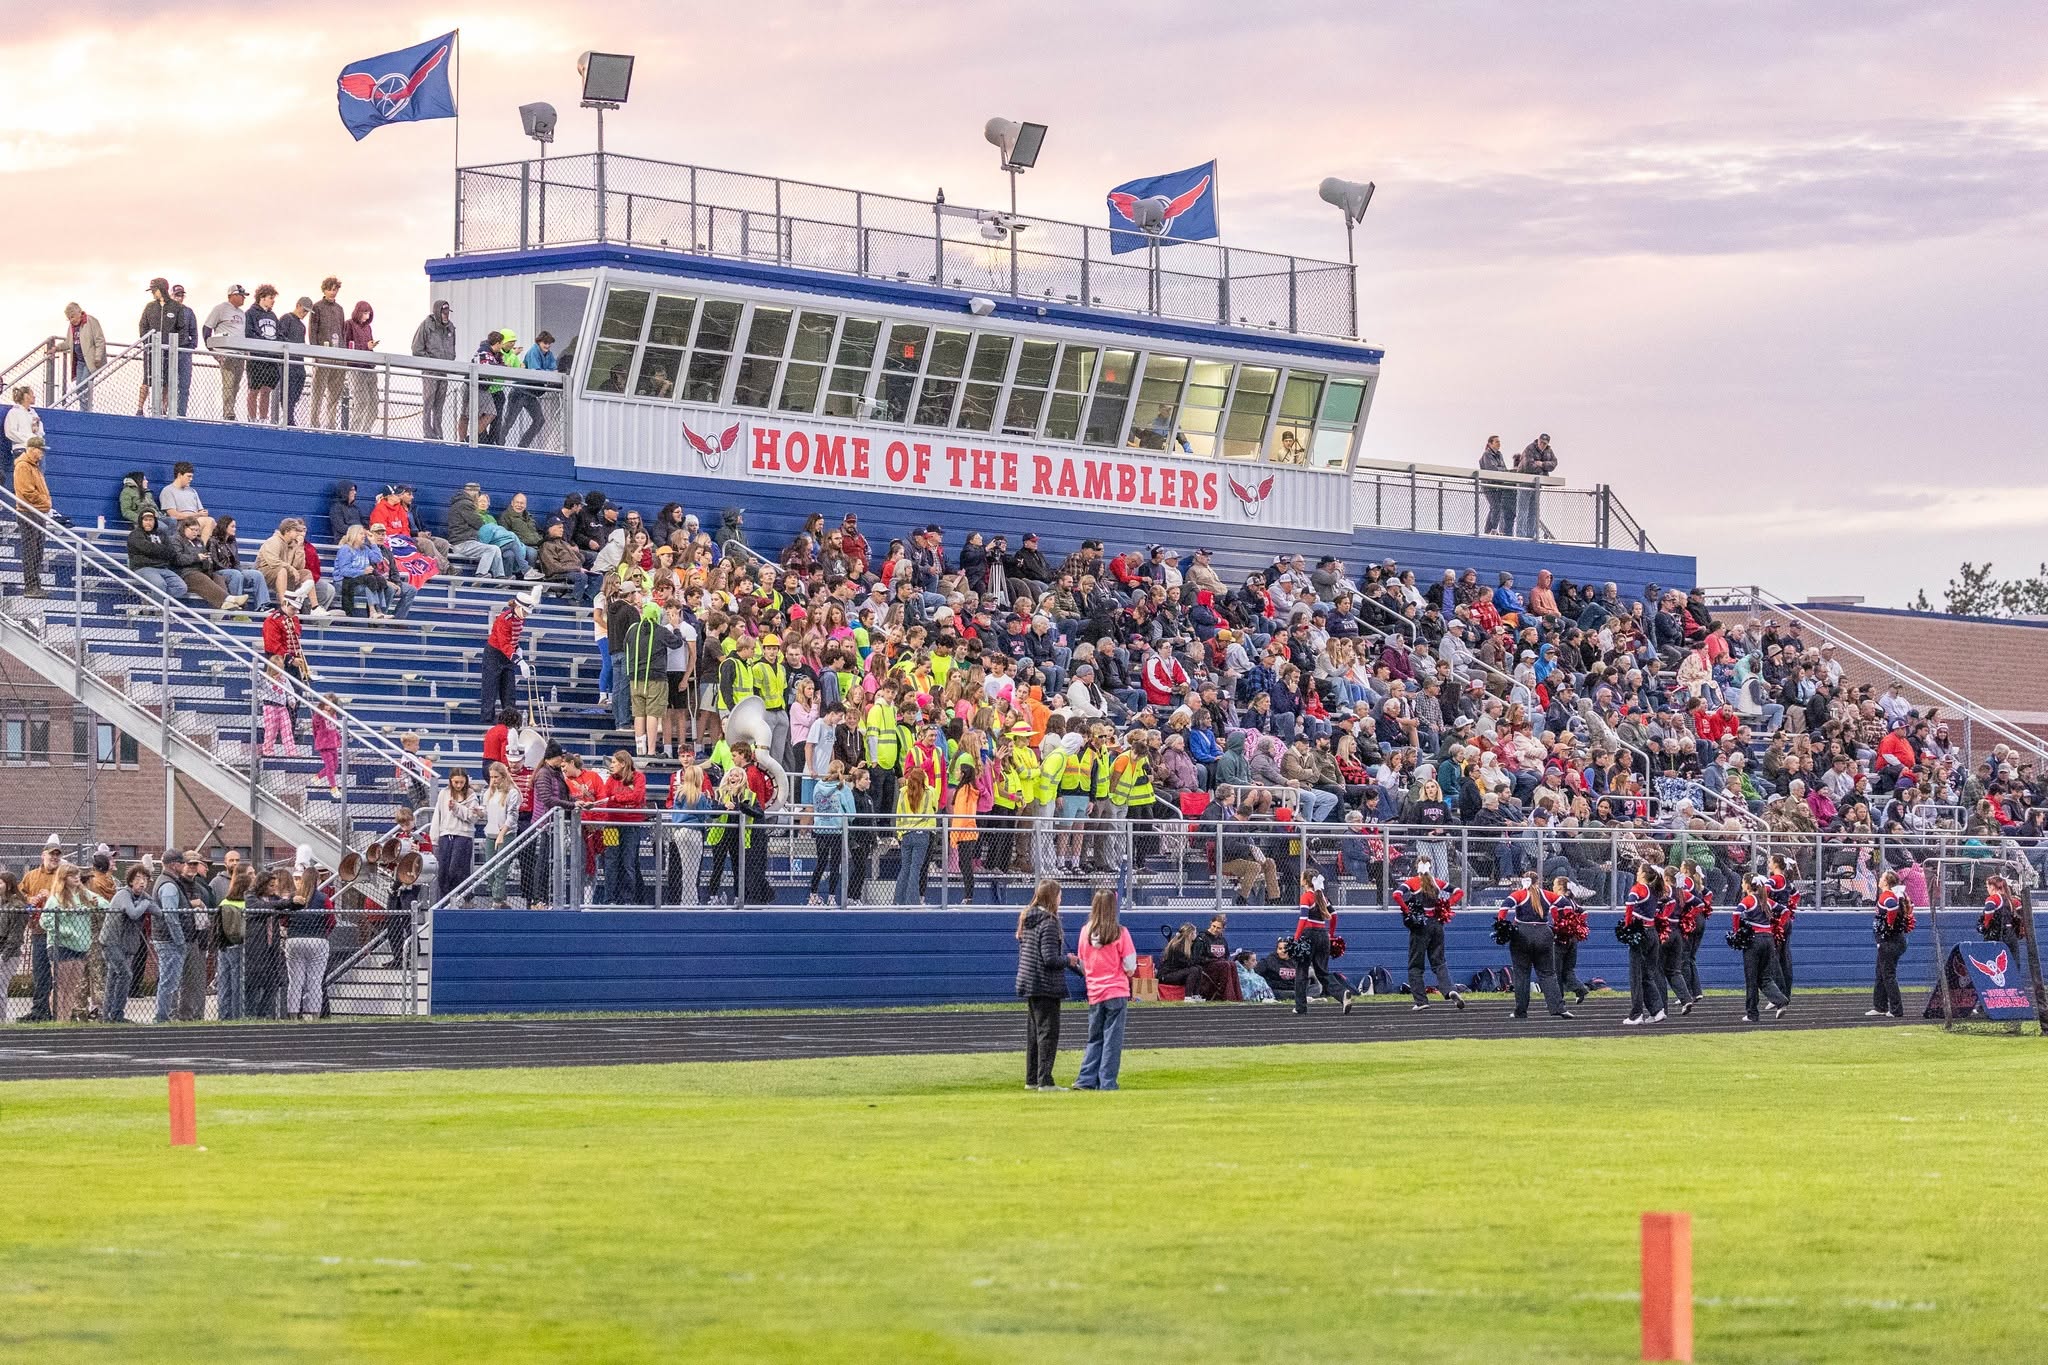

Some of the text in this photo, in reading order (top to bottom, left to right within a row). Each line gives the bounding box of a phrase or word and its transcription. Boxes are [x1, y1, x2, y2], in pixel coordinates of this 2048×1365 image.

[752, 427, 1218, 511] HOME OF THE RAMBLERS
